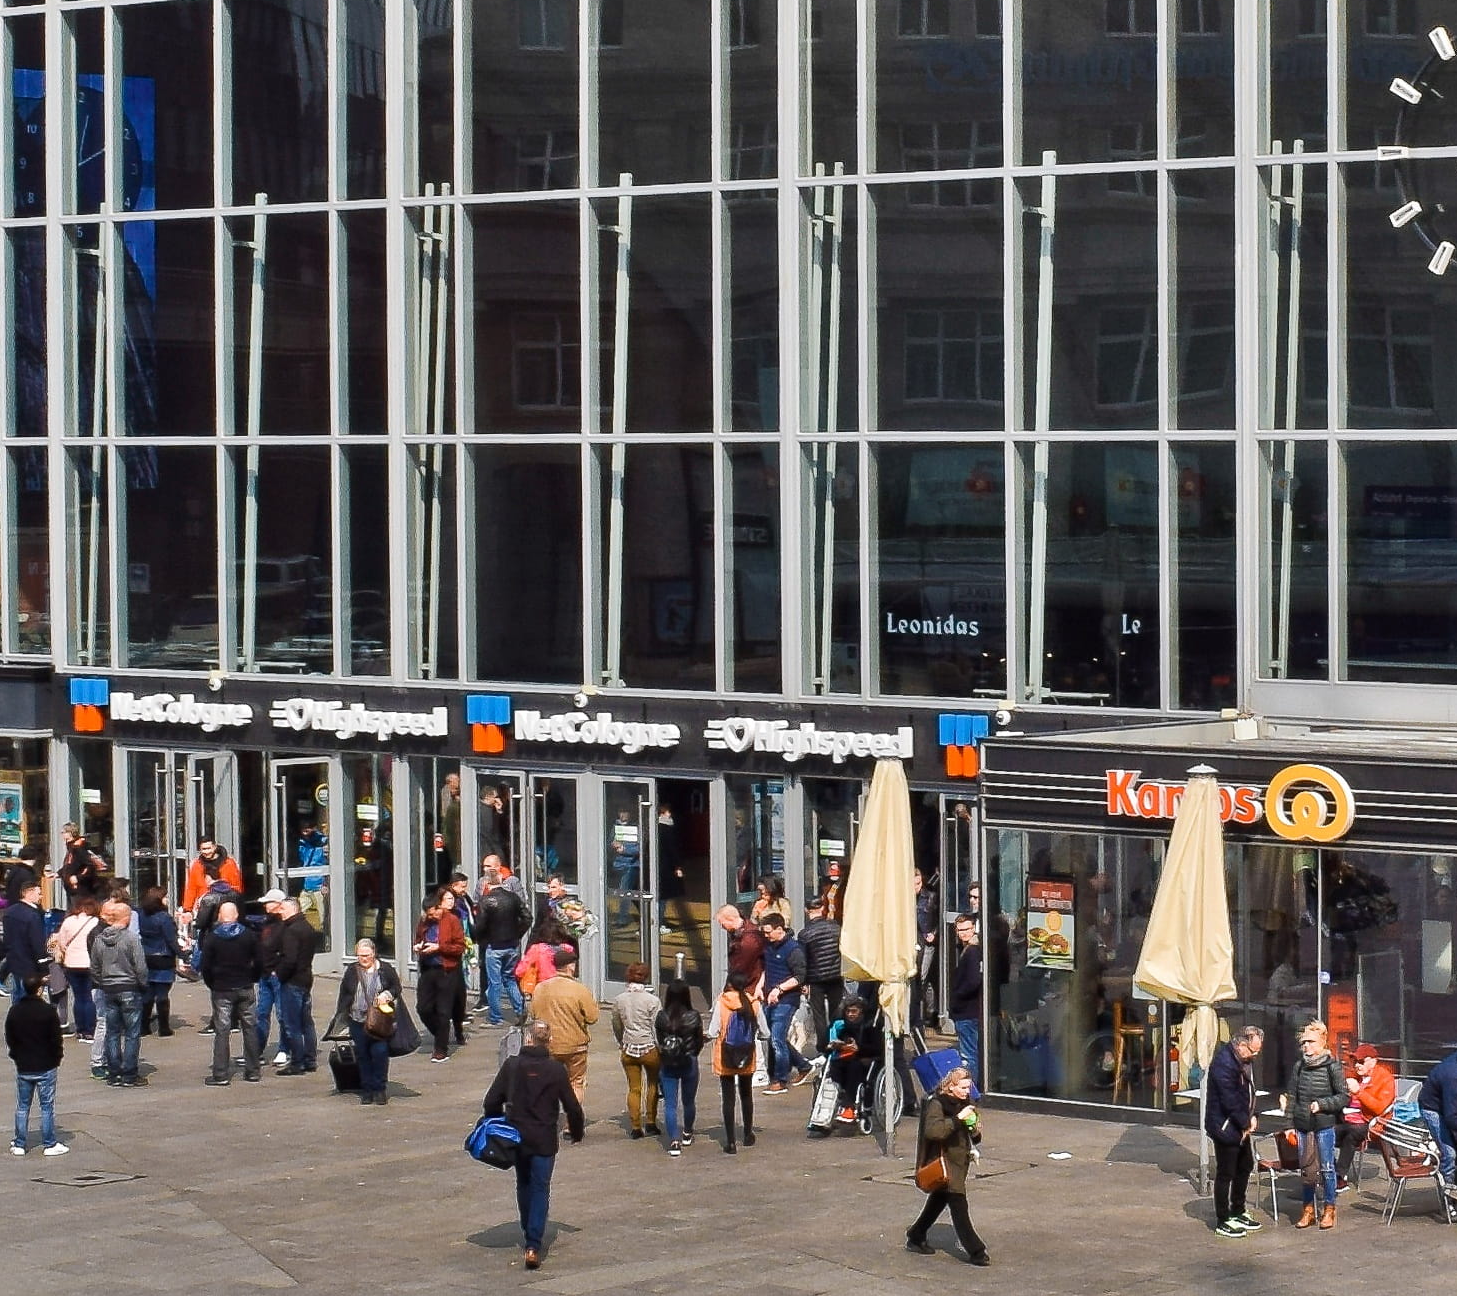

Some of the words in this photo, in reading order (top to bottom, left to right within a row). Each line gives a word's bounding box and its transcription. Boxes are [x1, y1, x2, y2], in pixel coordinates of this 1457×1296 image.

[886, 612, 980, 637] Leonidas
[1121, 613, 1142, 635] Le
[109, 691, 253, 733] NetCologne
[312, 699, 448, 741] Highspeed
[514, 710, 681, 755] NetCologne
[755, 720, 913, 763] Highspeed
